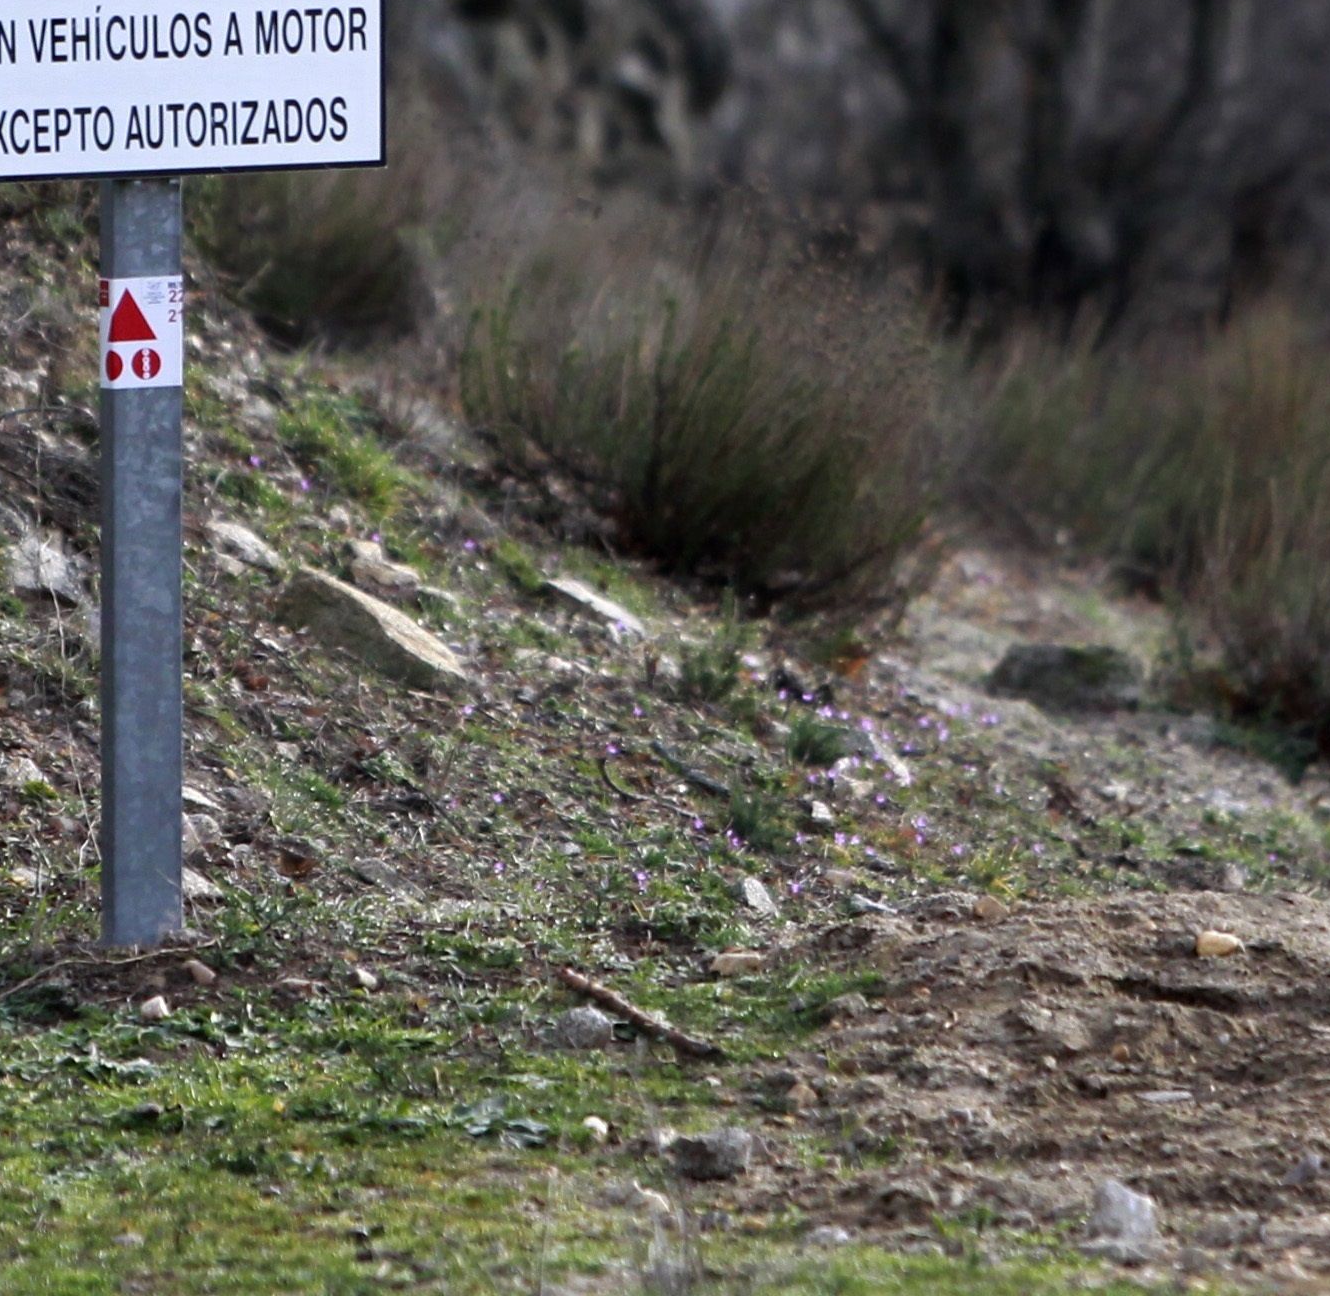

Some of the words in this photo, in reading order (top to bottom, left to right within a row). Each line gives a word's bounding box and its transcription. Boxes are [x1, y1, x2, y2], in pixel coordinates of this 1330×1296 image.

[29, 6, 212, 63] VEHÍCULOS
[224, 12, 243, 55] A
[256, 7, 366, 54] MOTOR
[126, 97, 347, 149] AUTORIZADOS
